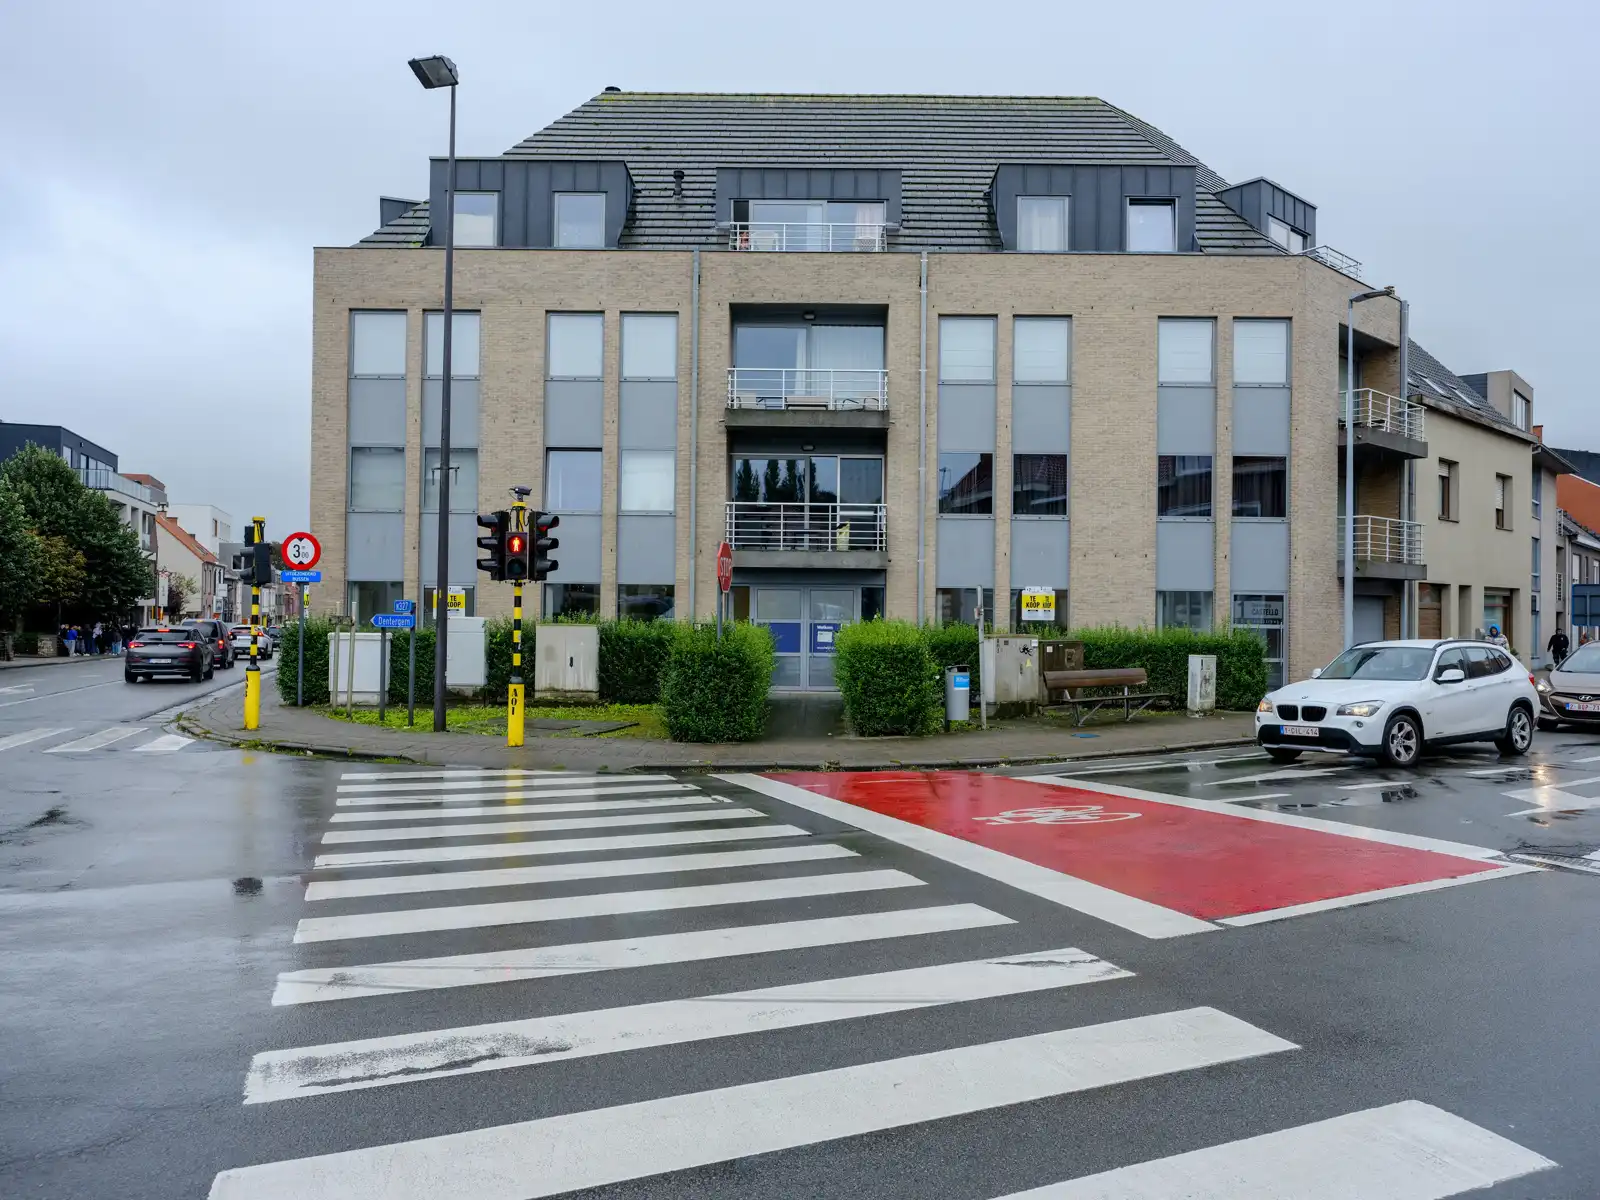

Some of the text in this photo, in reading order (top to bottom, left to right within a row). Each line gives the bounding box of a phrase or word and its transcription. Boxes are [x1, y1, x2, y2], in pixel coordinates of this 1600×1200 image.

[292, 544, 301, 558] 3
[720, 557, 732, 577] STOP
[1252, 608, 1279, 616] CASTELLO
[378, 616, 411, 627] Dentergem
[1284, 727, 1318, 736] 1-CIL-414
